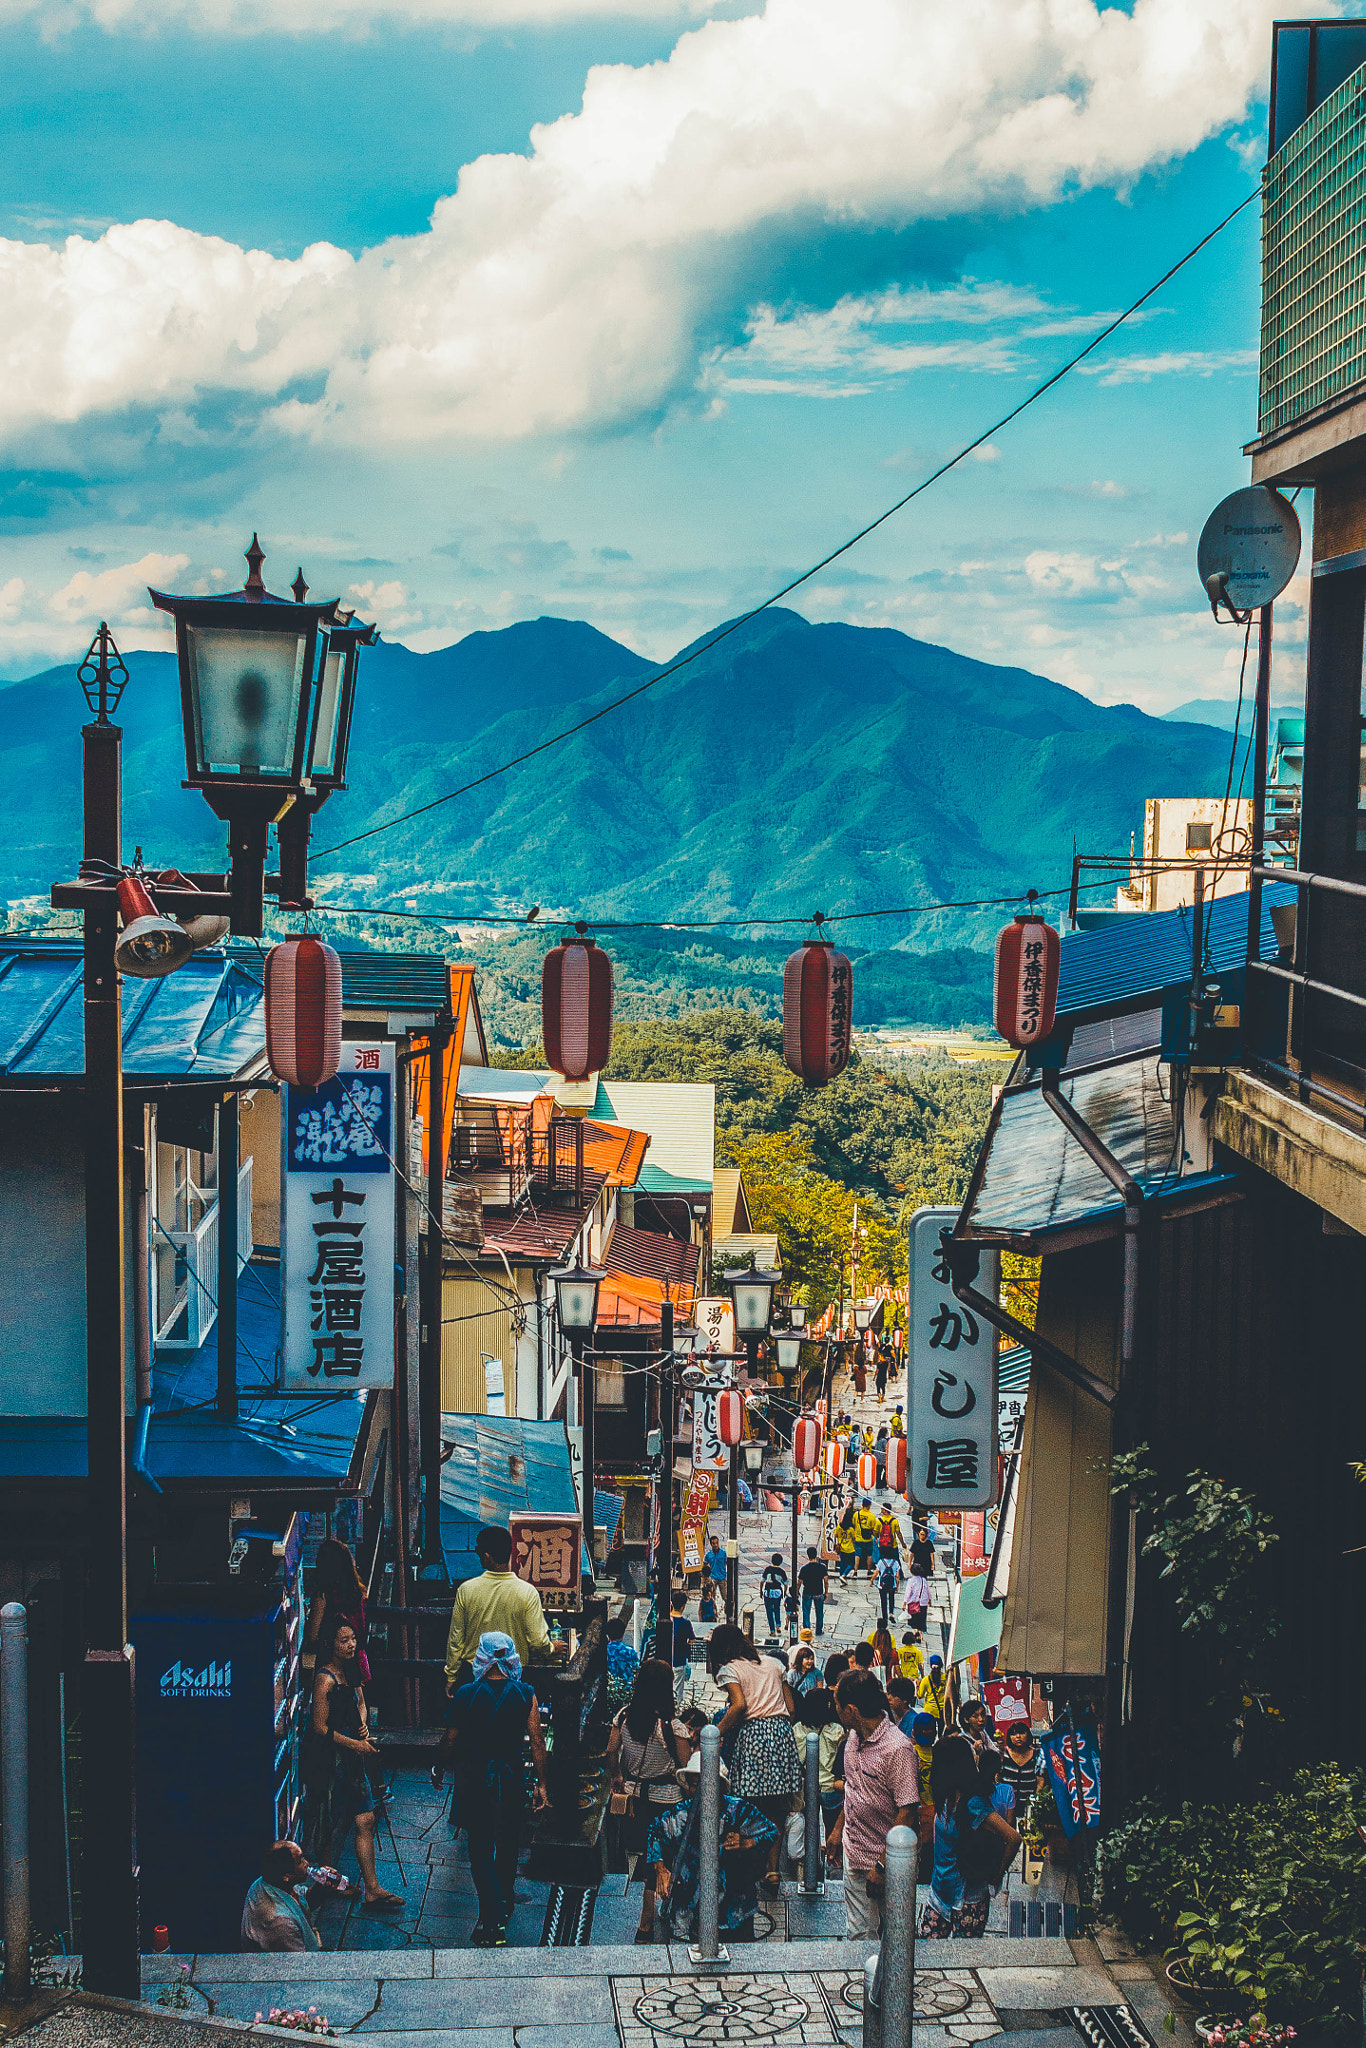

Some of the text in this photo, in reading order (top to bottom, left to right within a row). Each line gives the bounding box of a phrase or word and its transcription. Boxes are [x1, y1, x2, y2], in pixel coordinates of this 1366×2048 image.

[1223, 523, 1283, 536] Panasonic
[1243, 571, 1271, 581] DIGITAL
[1021, 941, 1044, 1034] 伊香保まつり
[830, 965, 848, 1068] 伊香保まつり
[354, 1048, 381, 1070] 酒
[306, 1177, 367, 1379] 十一屋酒店
[516, 1526, 574, 1585] 酒
[685, 1557, 701, 1567] 入口
[964, 1556, 991, 1568] 中央
[160, 1660, 231, 1687] Asahi
[160, 1688, 231, 1697] SOFT DRINKS
